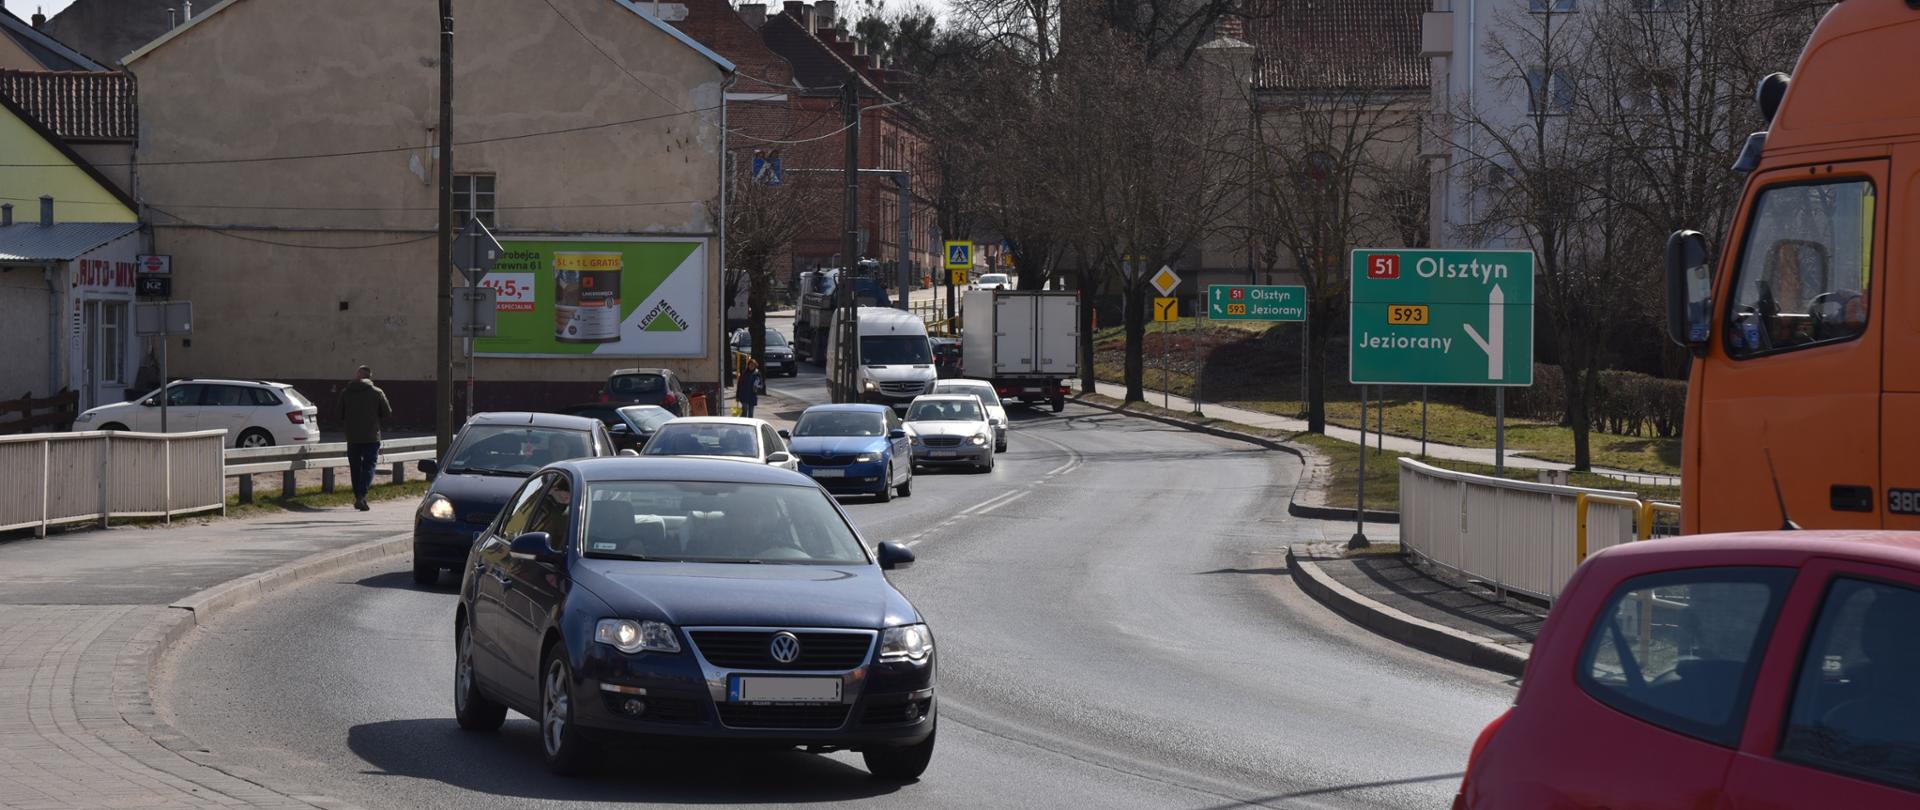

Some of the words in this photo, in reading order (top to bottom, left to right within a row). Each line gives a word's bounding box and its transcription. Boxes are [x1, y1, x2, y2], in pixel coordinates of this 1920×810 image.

[530, 261, 536, 270] 6
[591, 259, 619, 267] GRATIS
[1375, 259, 1392, 275] 51
[1416, 257, 1508, 284] Olsztyn
[146, 281, 162, 289] K2
[1251, 289, 1290, 302] Olsztyn
[637, 304, 661, 330] LEROY
[658, 299, 689, 330] MERLIN
[1229, 305, 1244, 313] 593
[1251, 304, 1302, 317] Jeziorany
[1394, 308, 1422, 321] 593
[1359, 332, 1452, 353] Jeziorany
